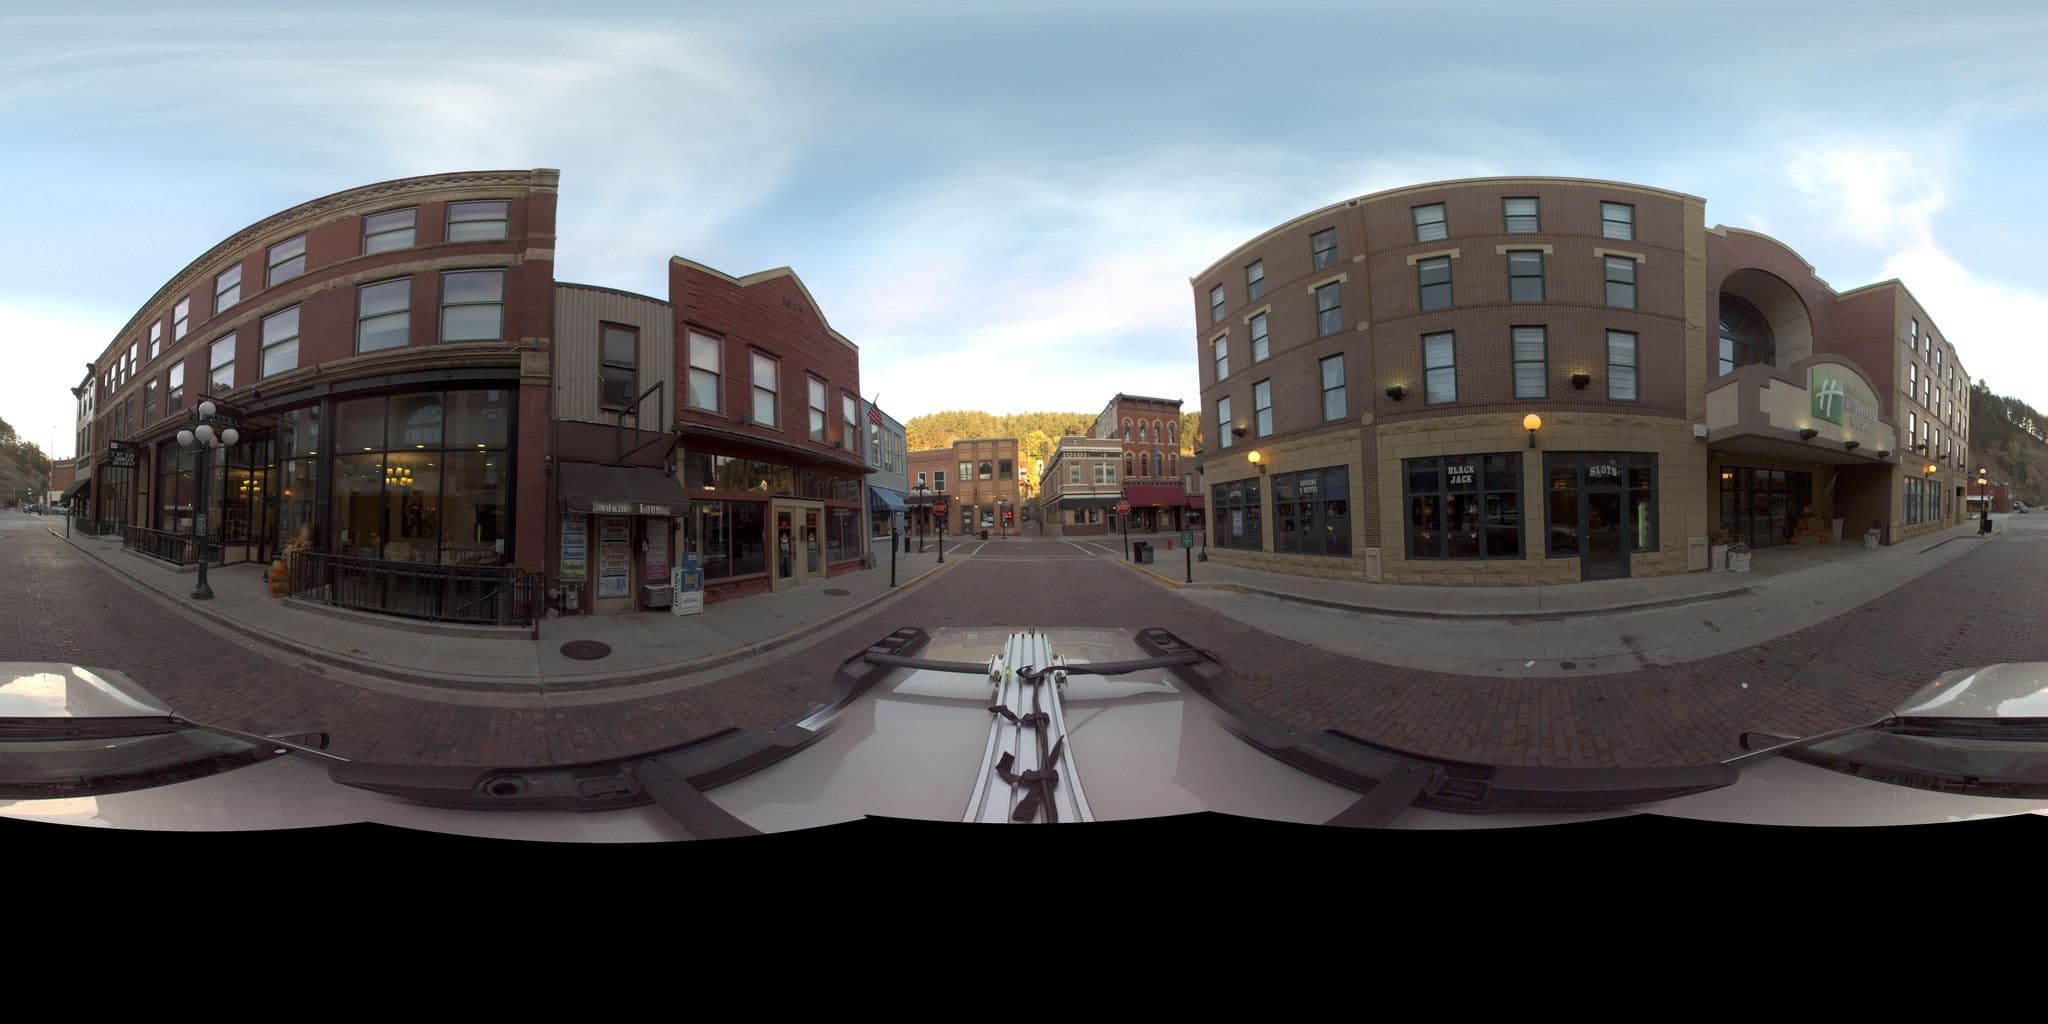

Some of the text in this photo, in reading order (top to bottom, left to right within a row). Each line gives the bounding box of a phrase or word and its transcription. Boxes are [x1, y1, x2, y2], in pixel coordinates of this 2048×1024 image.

[1447, 465, 1475, 475] BLACK
[1590, 465, 1617, 476] SLOTS
[1450, 475, 1473, 484] JACK
